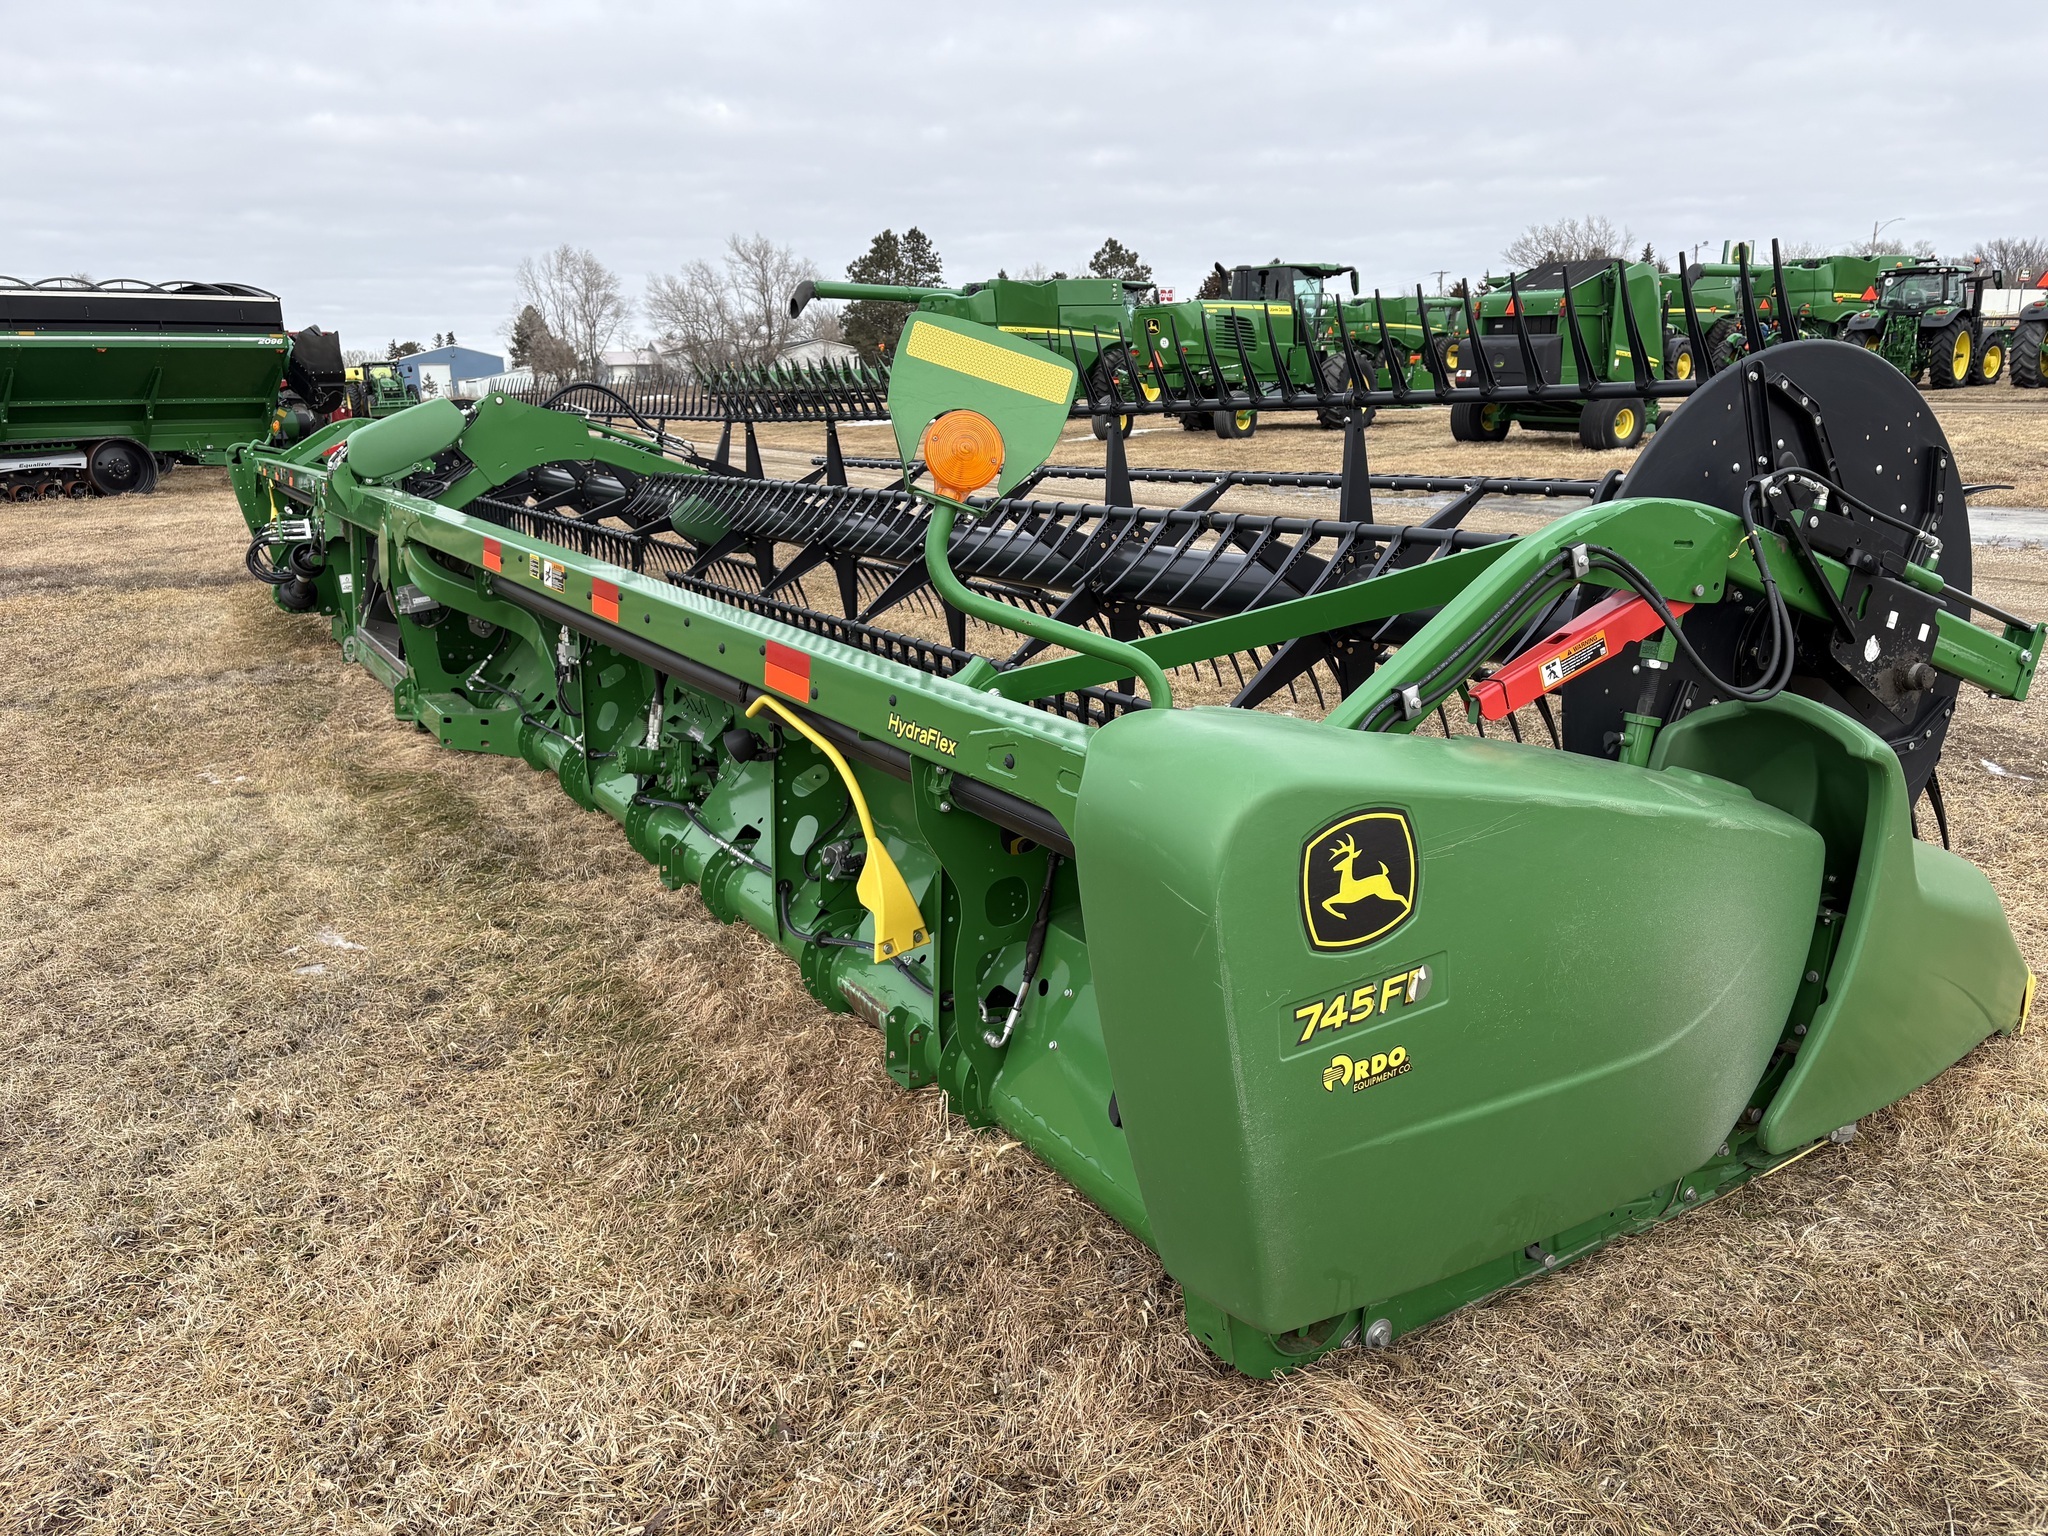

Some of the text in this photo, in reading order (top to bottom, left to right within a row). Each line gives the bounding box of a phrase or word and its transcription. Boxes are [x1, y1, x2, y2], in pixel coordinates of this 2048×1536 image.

[1573, 635, 1598, 652] WARNING
[887, 711, 959, 758] HydraFlex
[1353, 1063, 1413, 1093] EQUIPMENT CO.
